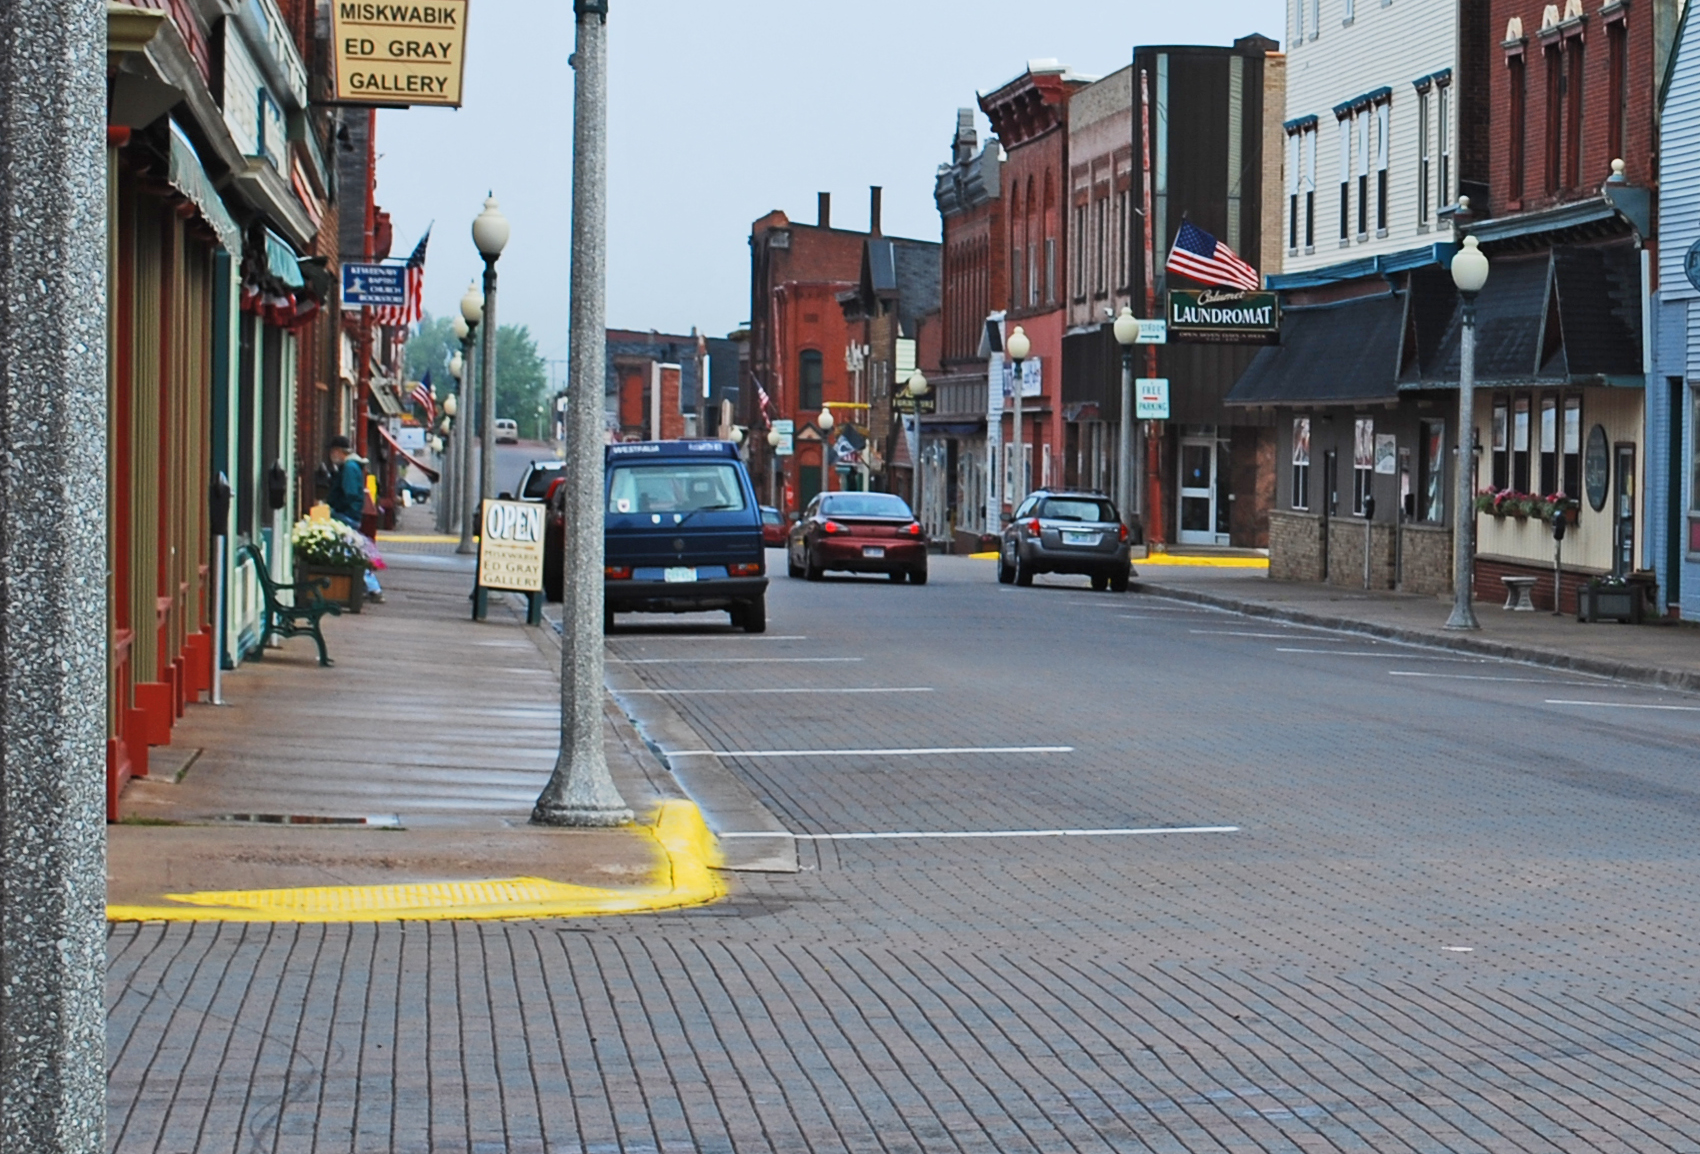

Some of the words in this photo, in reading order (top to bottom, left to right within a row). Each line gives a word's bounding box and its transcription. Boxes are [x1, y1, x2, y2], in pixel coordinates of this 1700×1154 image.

[340, 3, 457, 24] MISKWABIK
[345, 38, 375, 55] ED
[388, 40, 453, 59] GRAY
[349, 72, 449, 93] GALLERY
[1197, 289, 1245, 306] Calumet
[1173, 303, 1273, 325] LAUNDROMAT
[1142, 386, 1162, 395] FREE
[1139, 403, 1168, 412] PARKING
[487, 503, 542, 542] OPEN
[484, 560, 501, 570] ED
[506, 562, 540, 574] GRAY
[483, 573, 539, 586] GALLERY
